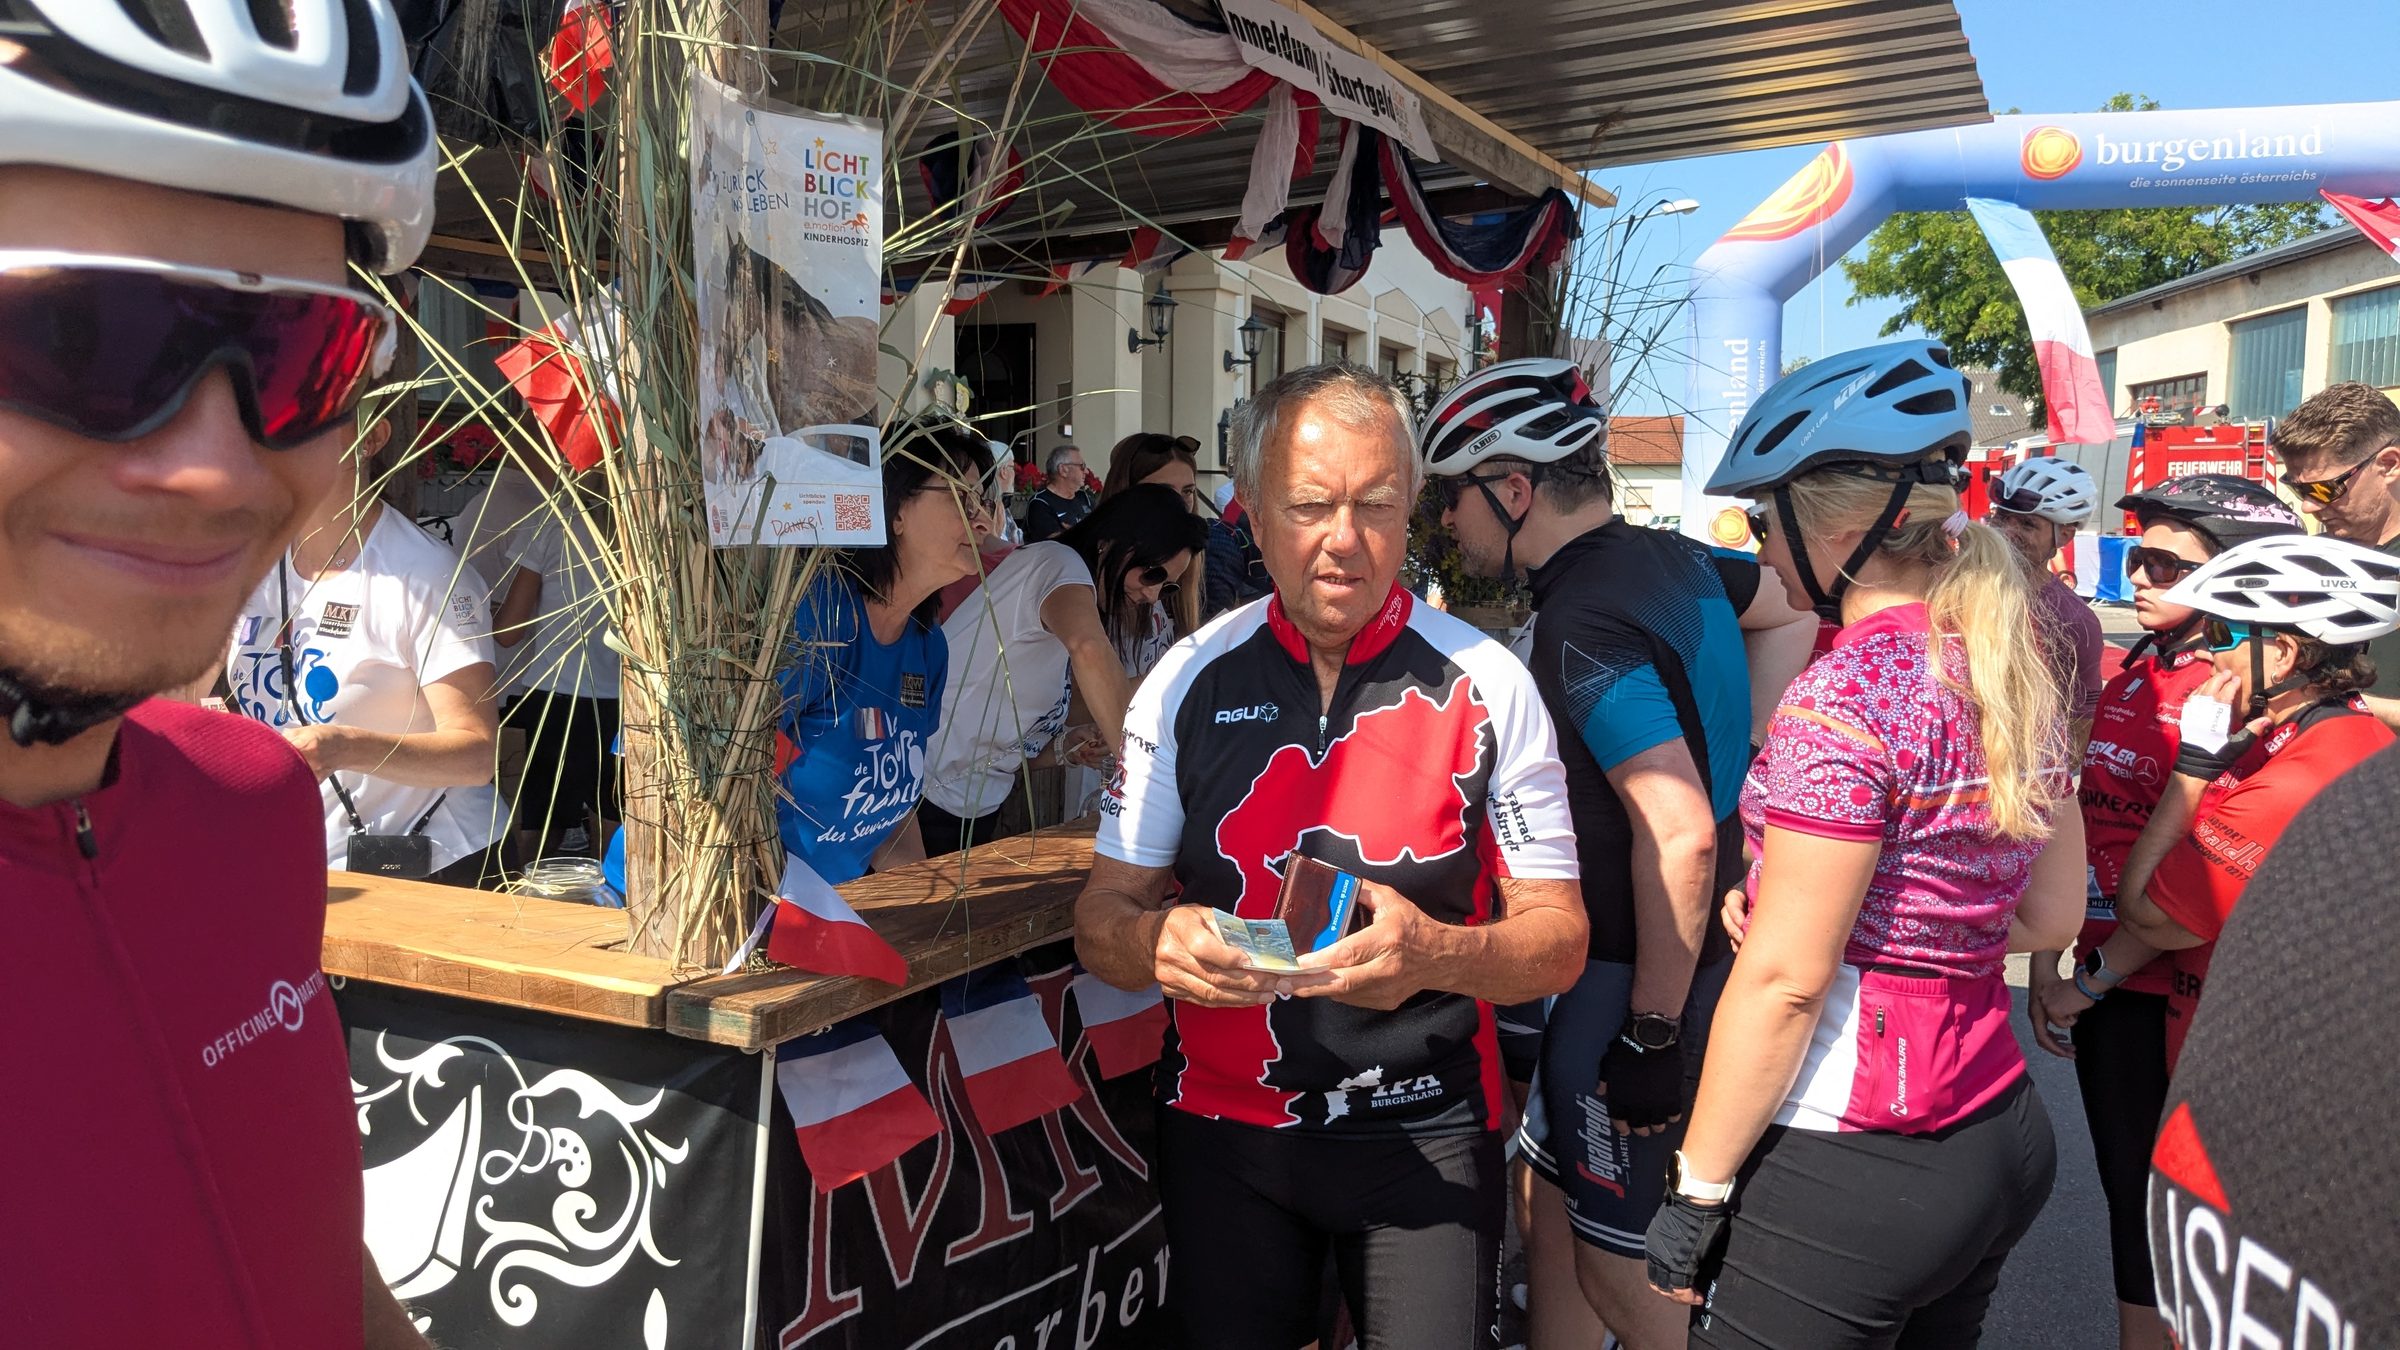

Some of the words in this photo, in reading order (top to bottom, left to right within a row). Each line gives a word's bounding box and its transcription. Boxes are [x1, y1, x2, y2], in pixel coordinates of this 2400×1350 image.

[2096, 123, 2324, 172] burgenland
[805, 149, 870, 176] LICHT
[804, 173, 869, 200] BLICK
[2129, 175, 2152, 189] die
[2153, 172, 2236, 188] sonnenseite
[2239, 168, 2317, 185] österreichs
[747, 192, 790, 213] LEBEN
[804, 197, 852, 220] HOF
[803, 220, 846, 233] e.motion
[803, 232, 869, 247] KINDERHOSPIZ
[1472, 432, 1498, 451] ABUS
[2167, 460, 2243, 476] FEUERWEHR
[2320, 579, 2358, 589] uvex
[323, 604, 359, 621] MKW
[232, 668, 245, 682] de
[1215, 705, 1259, 724] AGU
[854, 762, 868, 776] de
[1504, 791, 1536, 843] Fahrrad
[816, 825, 846, 843] des
[202, 1007, 278, 1067] OFFICINE
[1370, 1088, 1444, 1109] BURGENLAND
[1575, 1094, 1625, 1199] Segafredo
